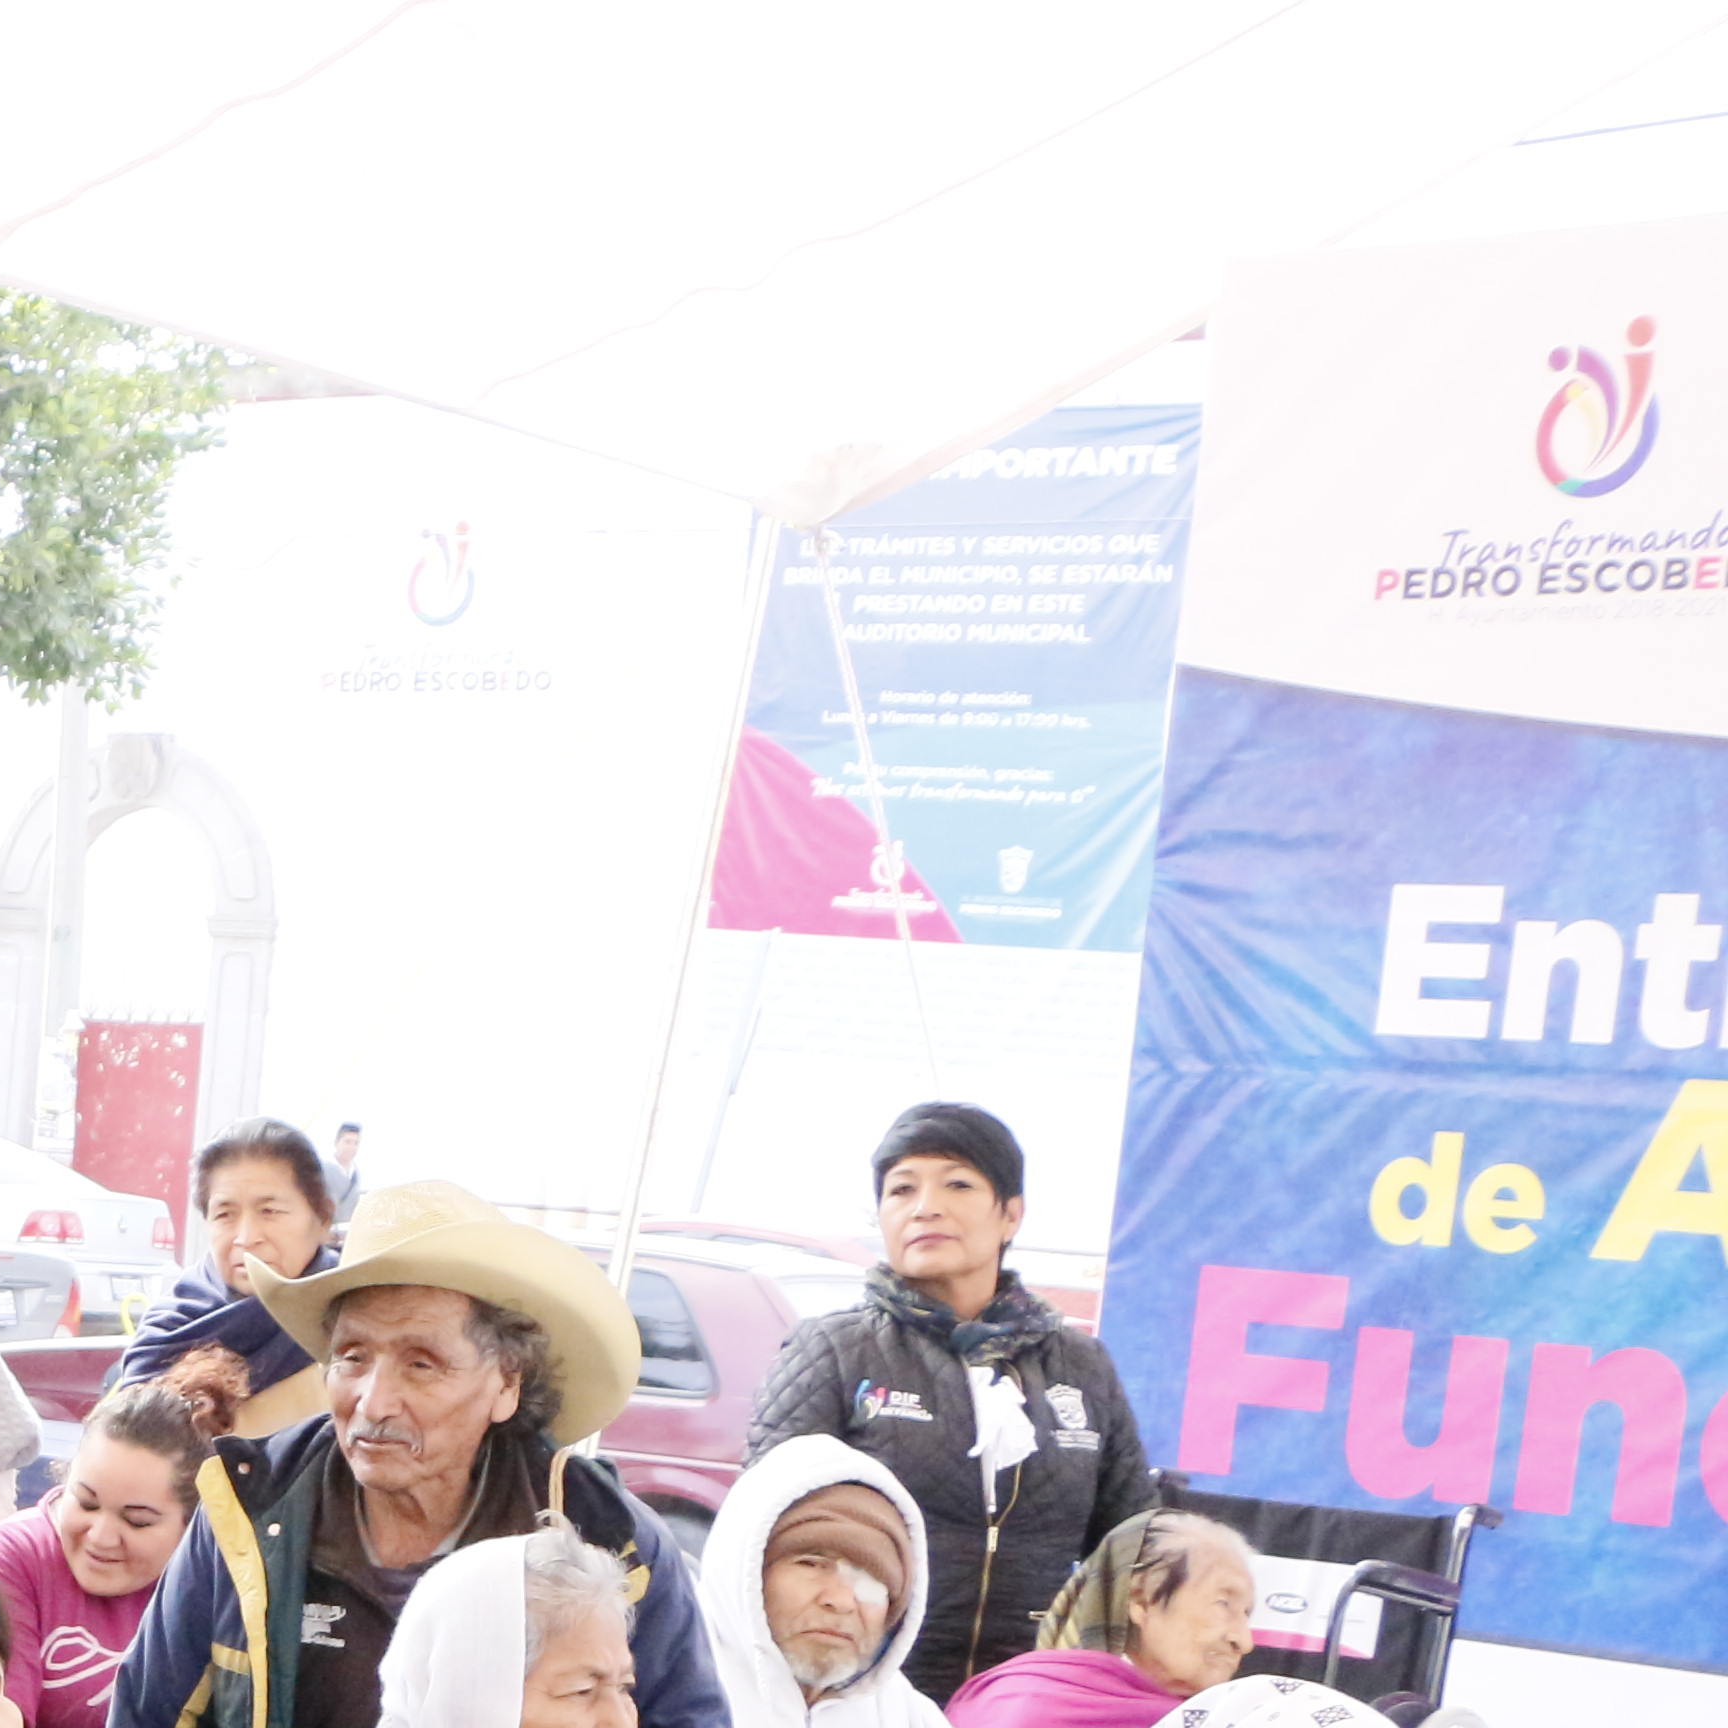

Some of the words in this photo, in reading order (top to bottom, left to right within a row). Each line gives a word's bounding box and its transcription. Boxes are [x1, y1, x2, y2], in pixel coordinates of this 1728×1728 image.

[849, 534, 956, 556] TRÁMITES
[962, 537, 979, 555] Y
[981, 535, 1104, 555] SERVICIOS
[1108, 534, 1162, 554] QUE
[869, 566, 896, 584] EL
[901, 565, 1022, 586] MUNICIPIO,
[1029, 565, 1056, 584] SE
[1062, 562, 1173, 584] ESTARÁN
[1374, 563, 1523, 600] PEDRO
[1536, 555, 1728, 597] ESCOBE
[853, 594, 987, 614] PRESTANDO
[991, 594, 1021, 613] EN
[1025, 594, 1087, 613] ESTE
[842, 623, 963, 643] AUDITORIO
[967, 624, 1092, 643] MUNICIPAL
[320, 670, 402, 692] PEDRO
[413, 670, 552, 692] ESCOBEDO
[880, 690, 935, 705] Horario
[939, 691, 959, 705] de
[962, 691, 1033, 705] atención:
[882, 711, 936, 724] Viernes
[940, 712, 958, 725] de
[1375, 883, 1728, 1050] Ent
[1369, 1131, 1546, 1254] de
[1177, 1264, 1728, 1528] Fun
